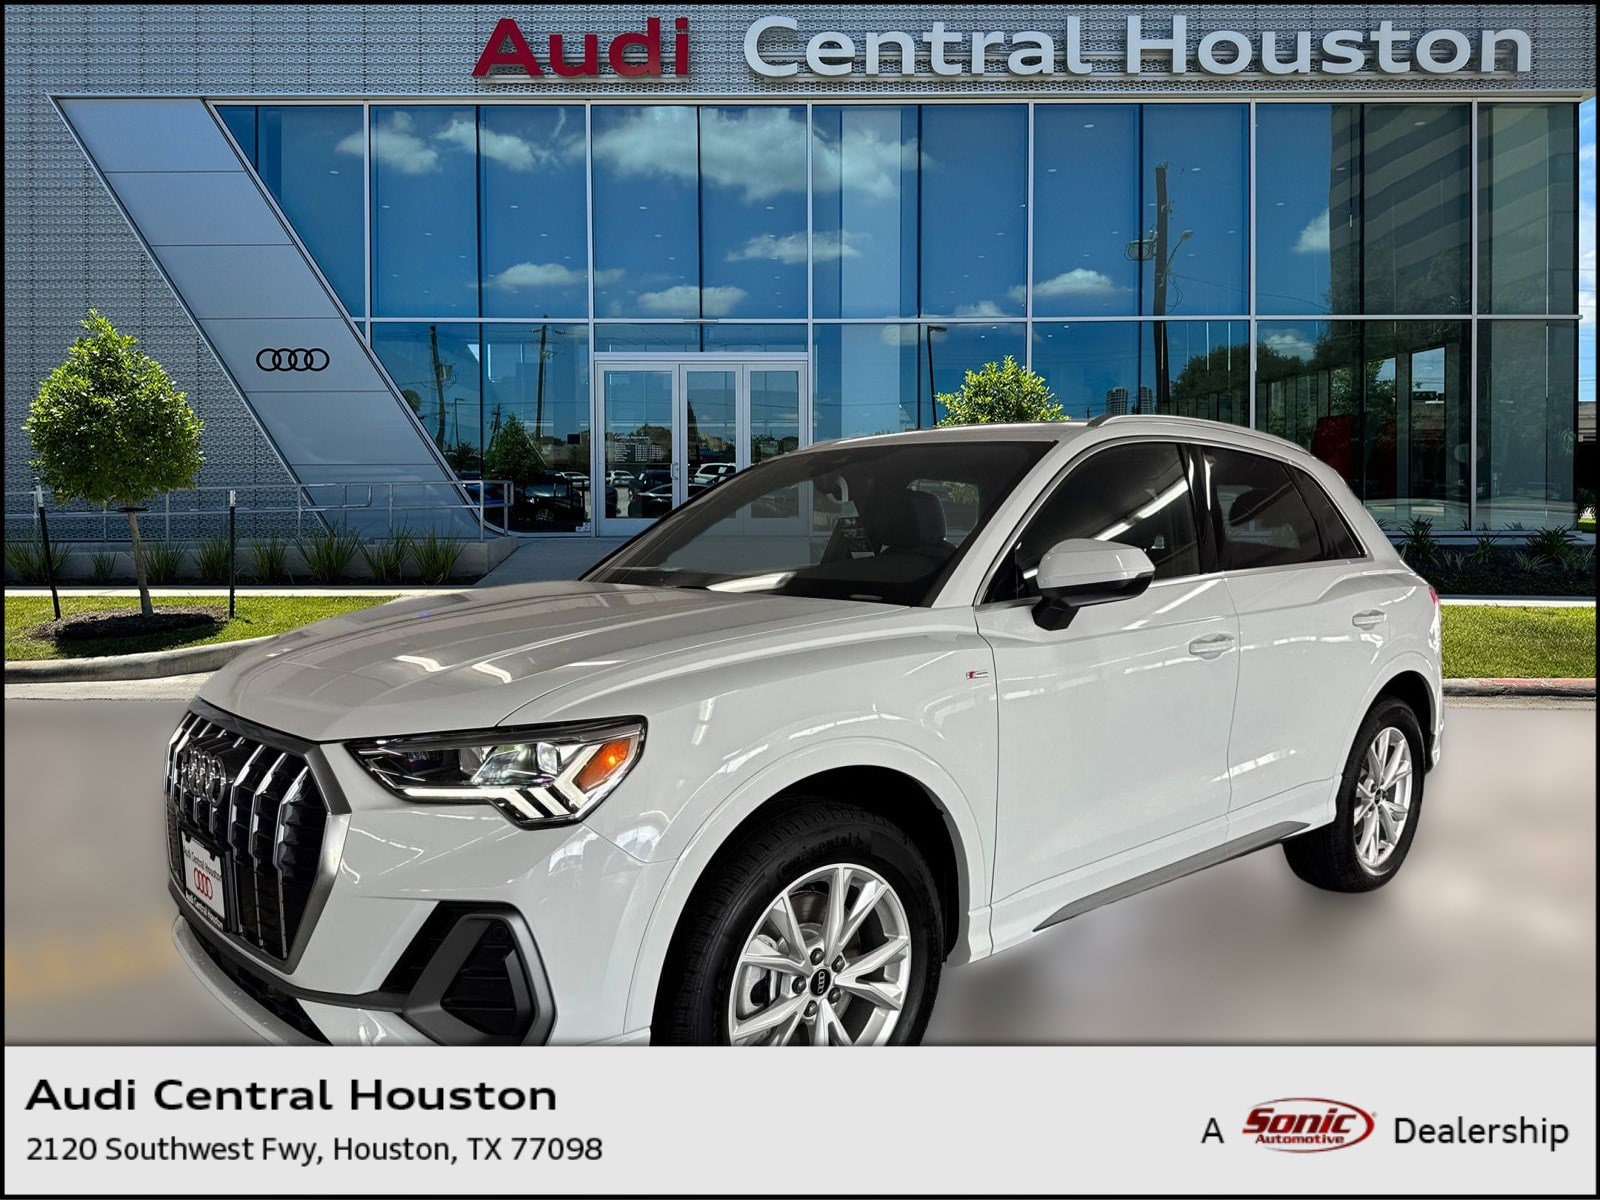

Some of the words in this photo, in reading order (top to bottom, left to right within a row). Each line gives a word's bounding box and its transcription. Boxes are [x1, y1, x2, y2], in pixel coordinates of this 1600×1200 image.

[471, 16, 689, 78] Audi
[744, 15, 1092, 77] Central
[1127, 15, 1532, 76] Houston
